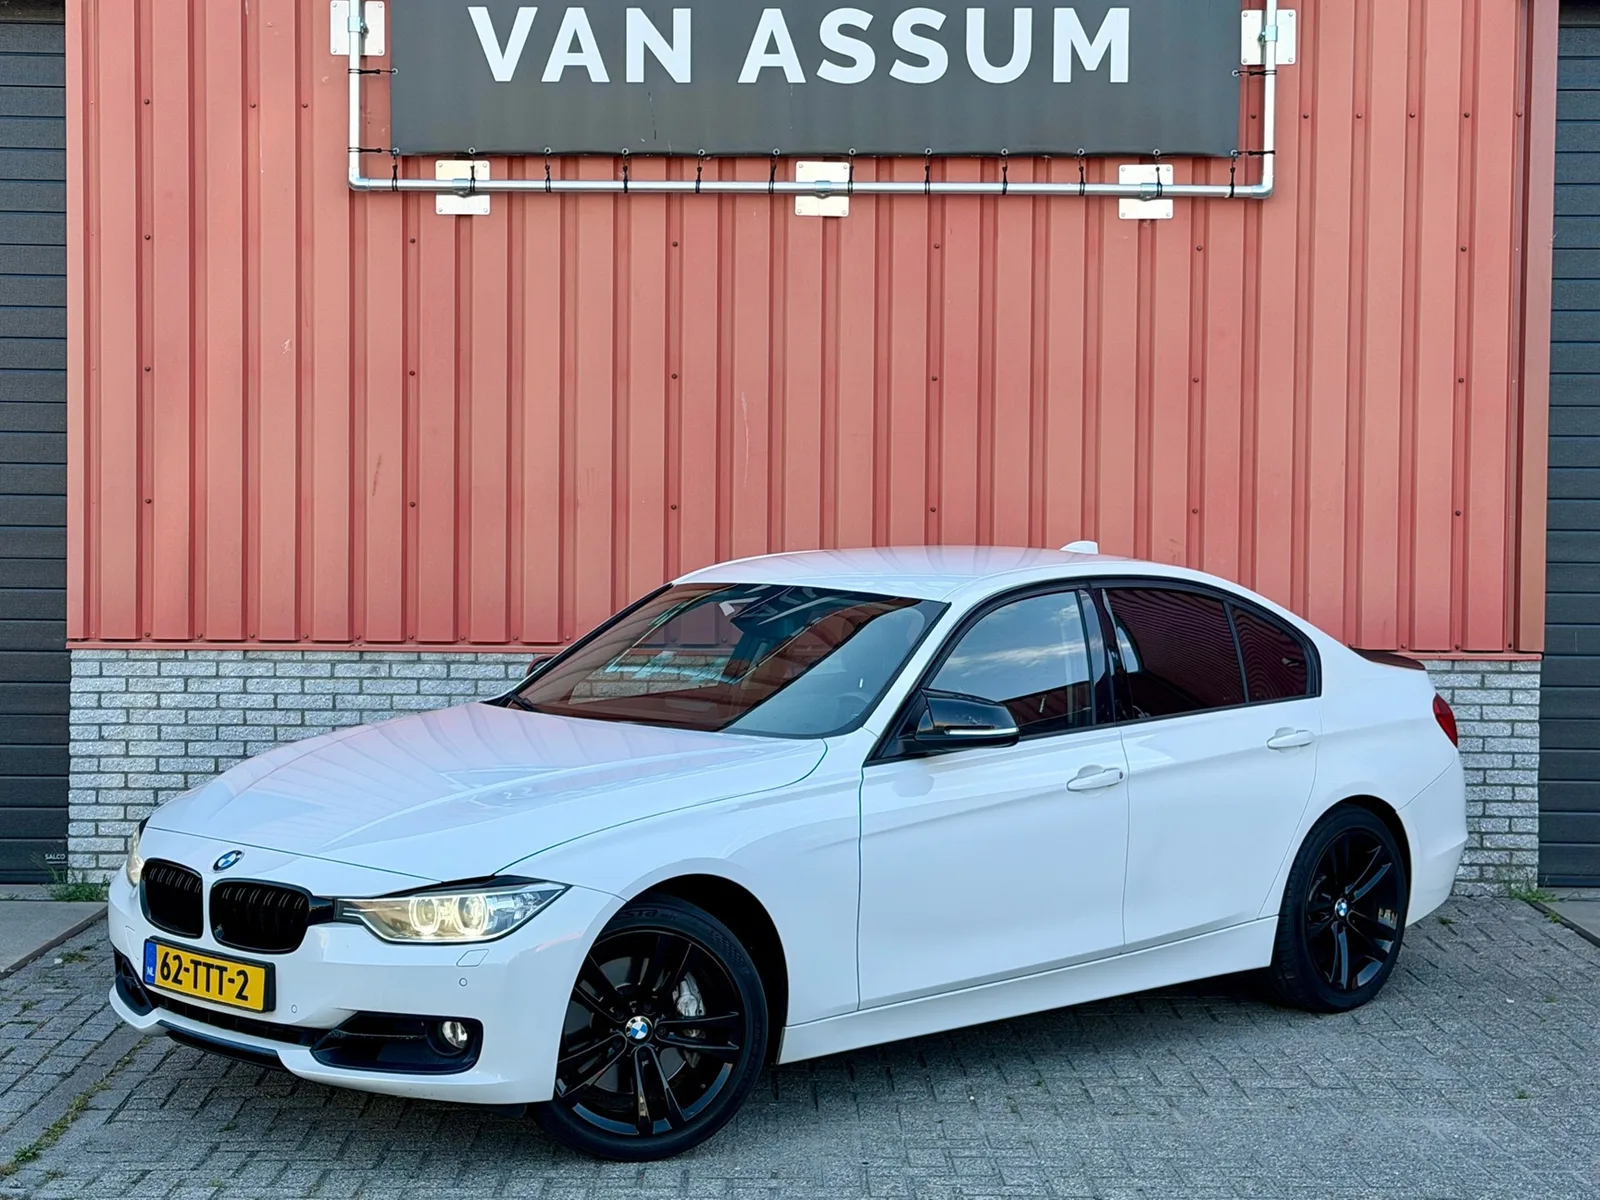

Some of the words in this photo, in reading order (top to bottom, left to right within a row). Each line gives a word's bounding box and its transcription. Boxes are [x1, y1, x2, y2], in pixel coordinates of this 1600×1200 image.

[468, 7, 692, 83] VAN
[738, 8, 1130, 83] ASSUM
[146, 966, 155, 977] NL
[160, 951, 249, 1001] 62-TTT-2
